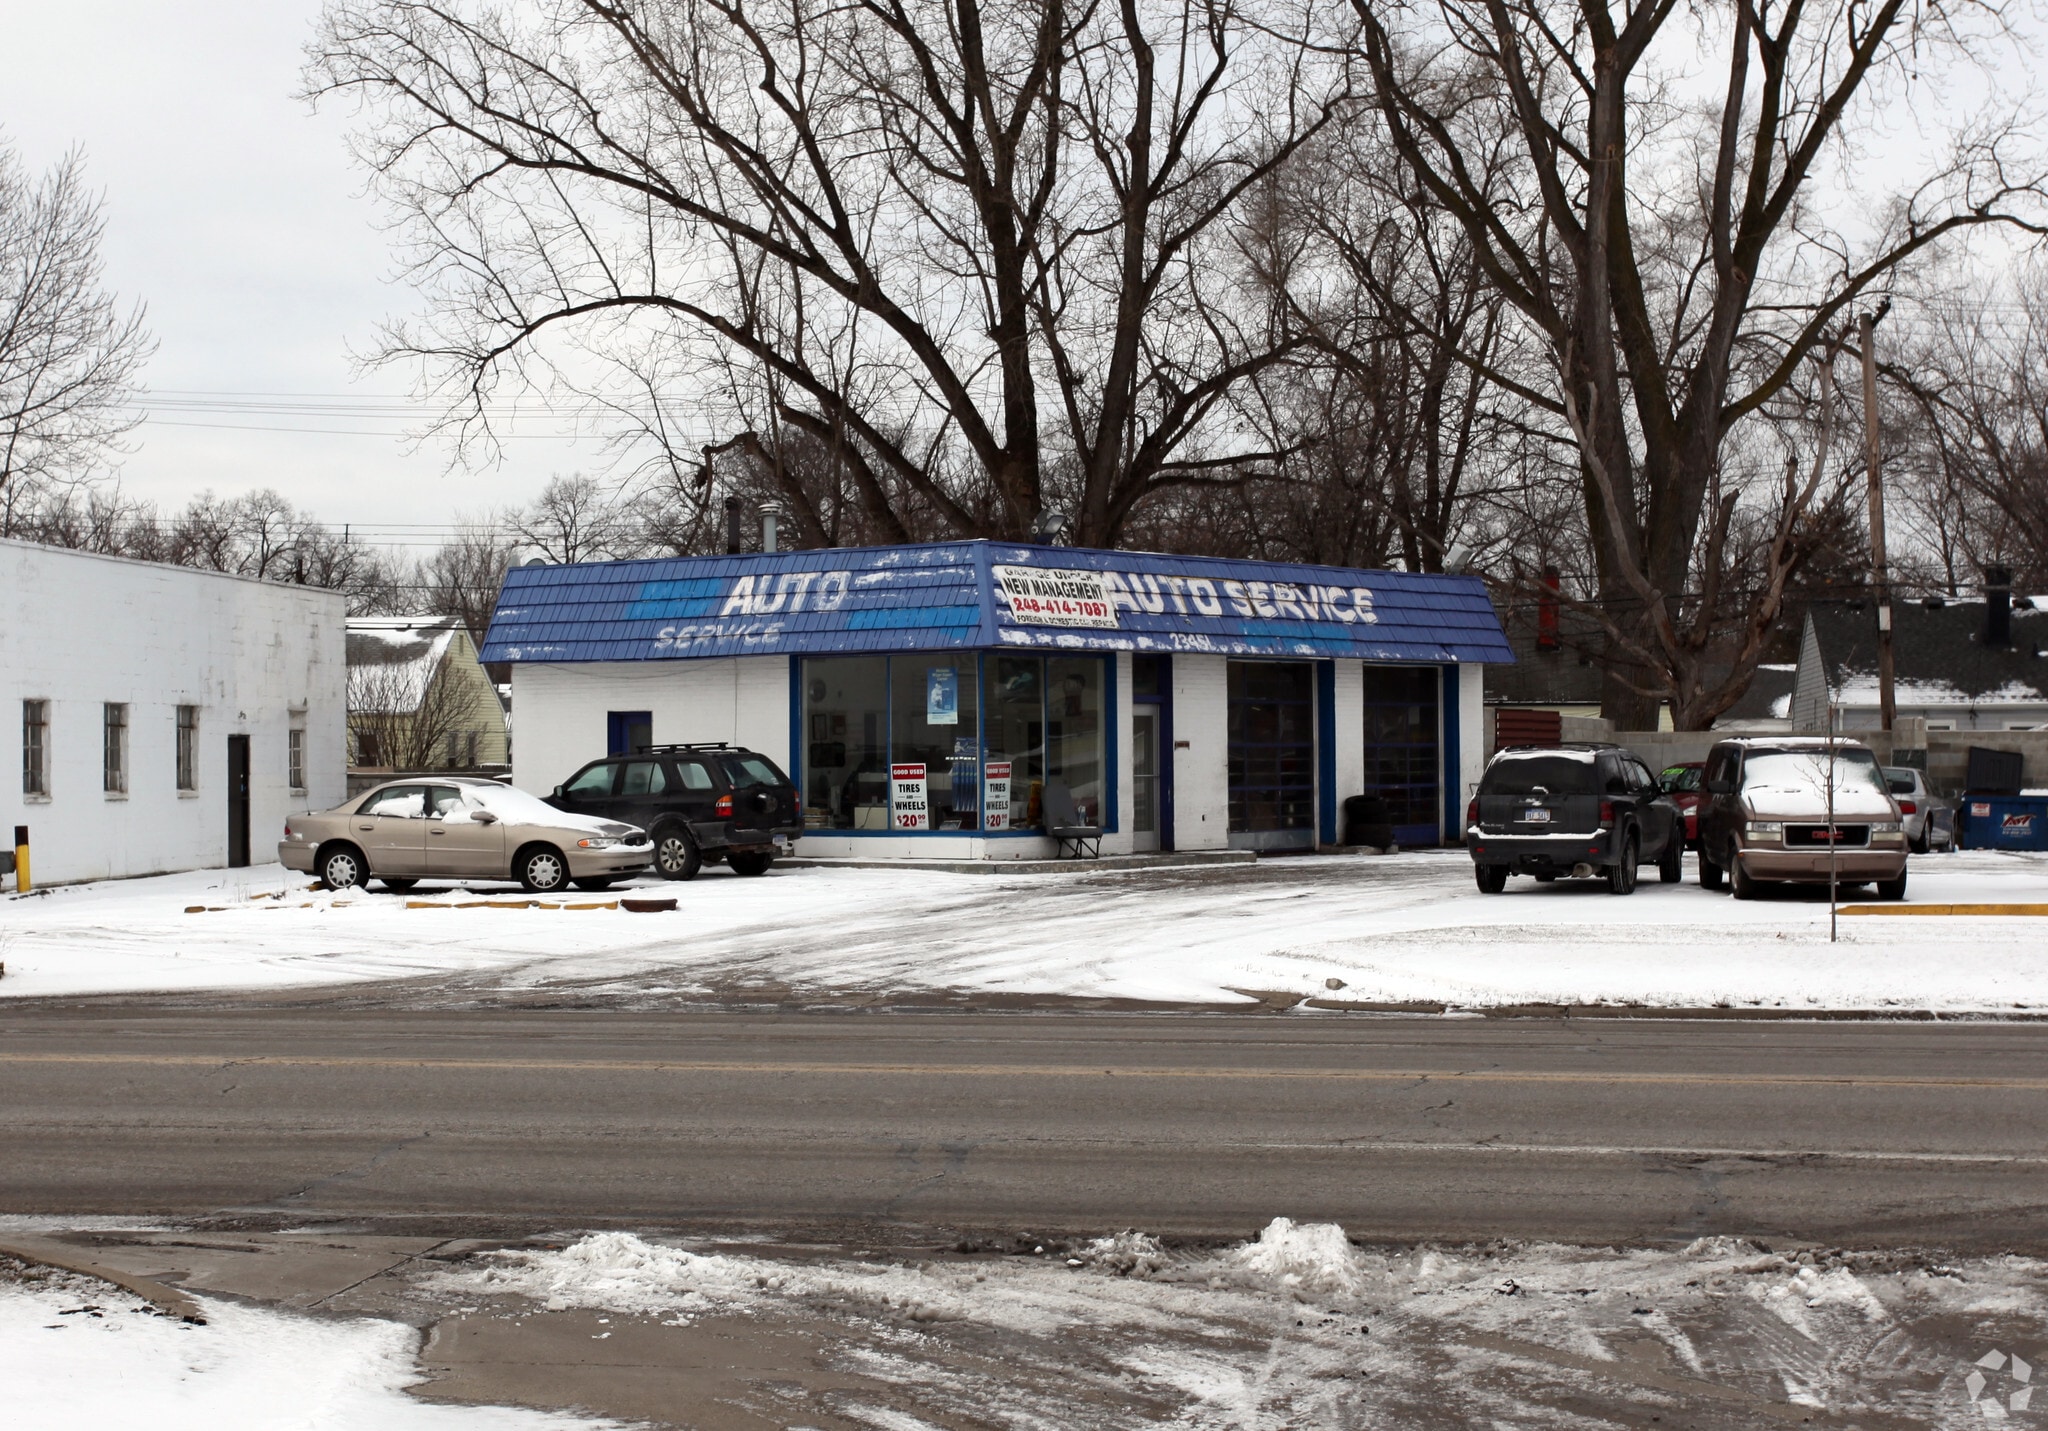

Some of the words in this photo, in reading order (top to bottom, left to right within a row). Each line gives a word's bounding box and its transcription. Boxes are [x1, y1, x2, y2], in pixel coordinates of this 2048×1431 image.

[1004, 567, 1052, 580] GARGE
[1054, 571, 1093, 581] UNER
[720, 571, 851, 619] AUTO
[1003, 577, 1031, 596] NEW
[1034, 580, 1103, 600] MANAGEMENT
[1101, 571, 1223, 617] AUTO
[1223, 579, 1379, 624] SERVICE
[1013, 597, 1107, 617] 248-414-7087
[654, 621, 786, 649] SERVICE
[898, 784, 920, 793] TIRES
[990, 783, 1006, 792] TIRES
[895, 801, 926, 810] WHEELS
[986, 801, 1008, 811] WHEELS
